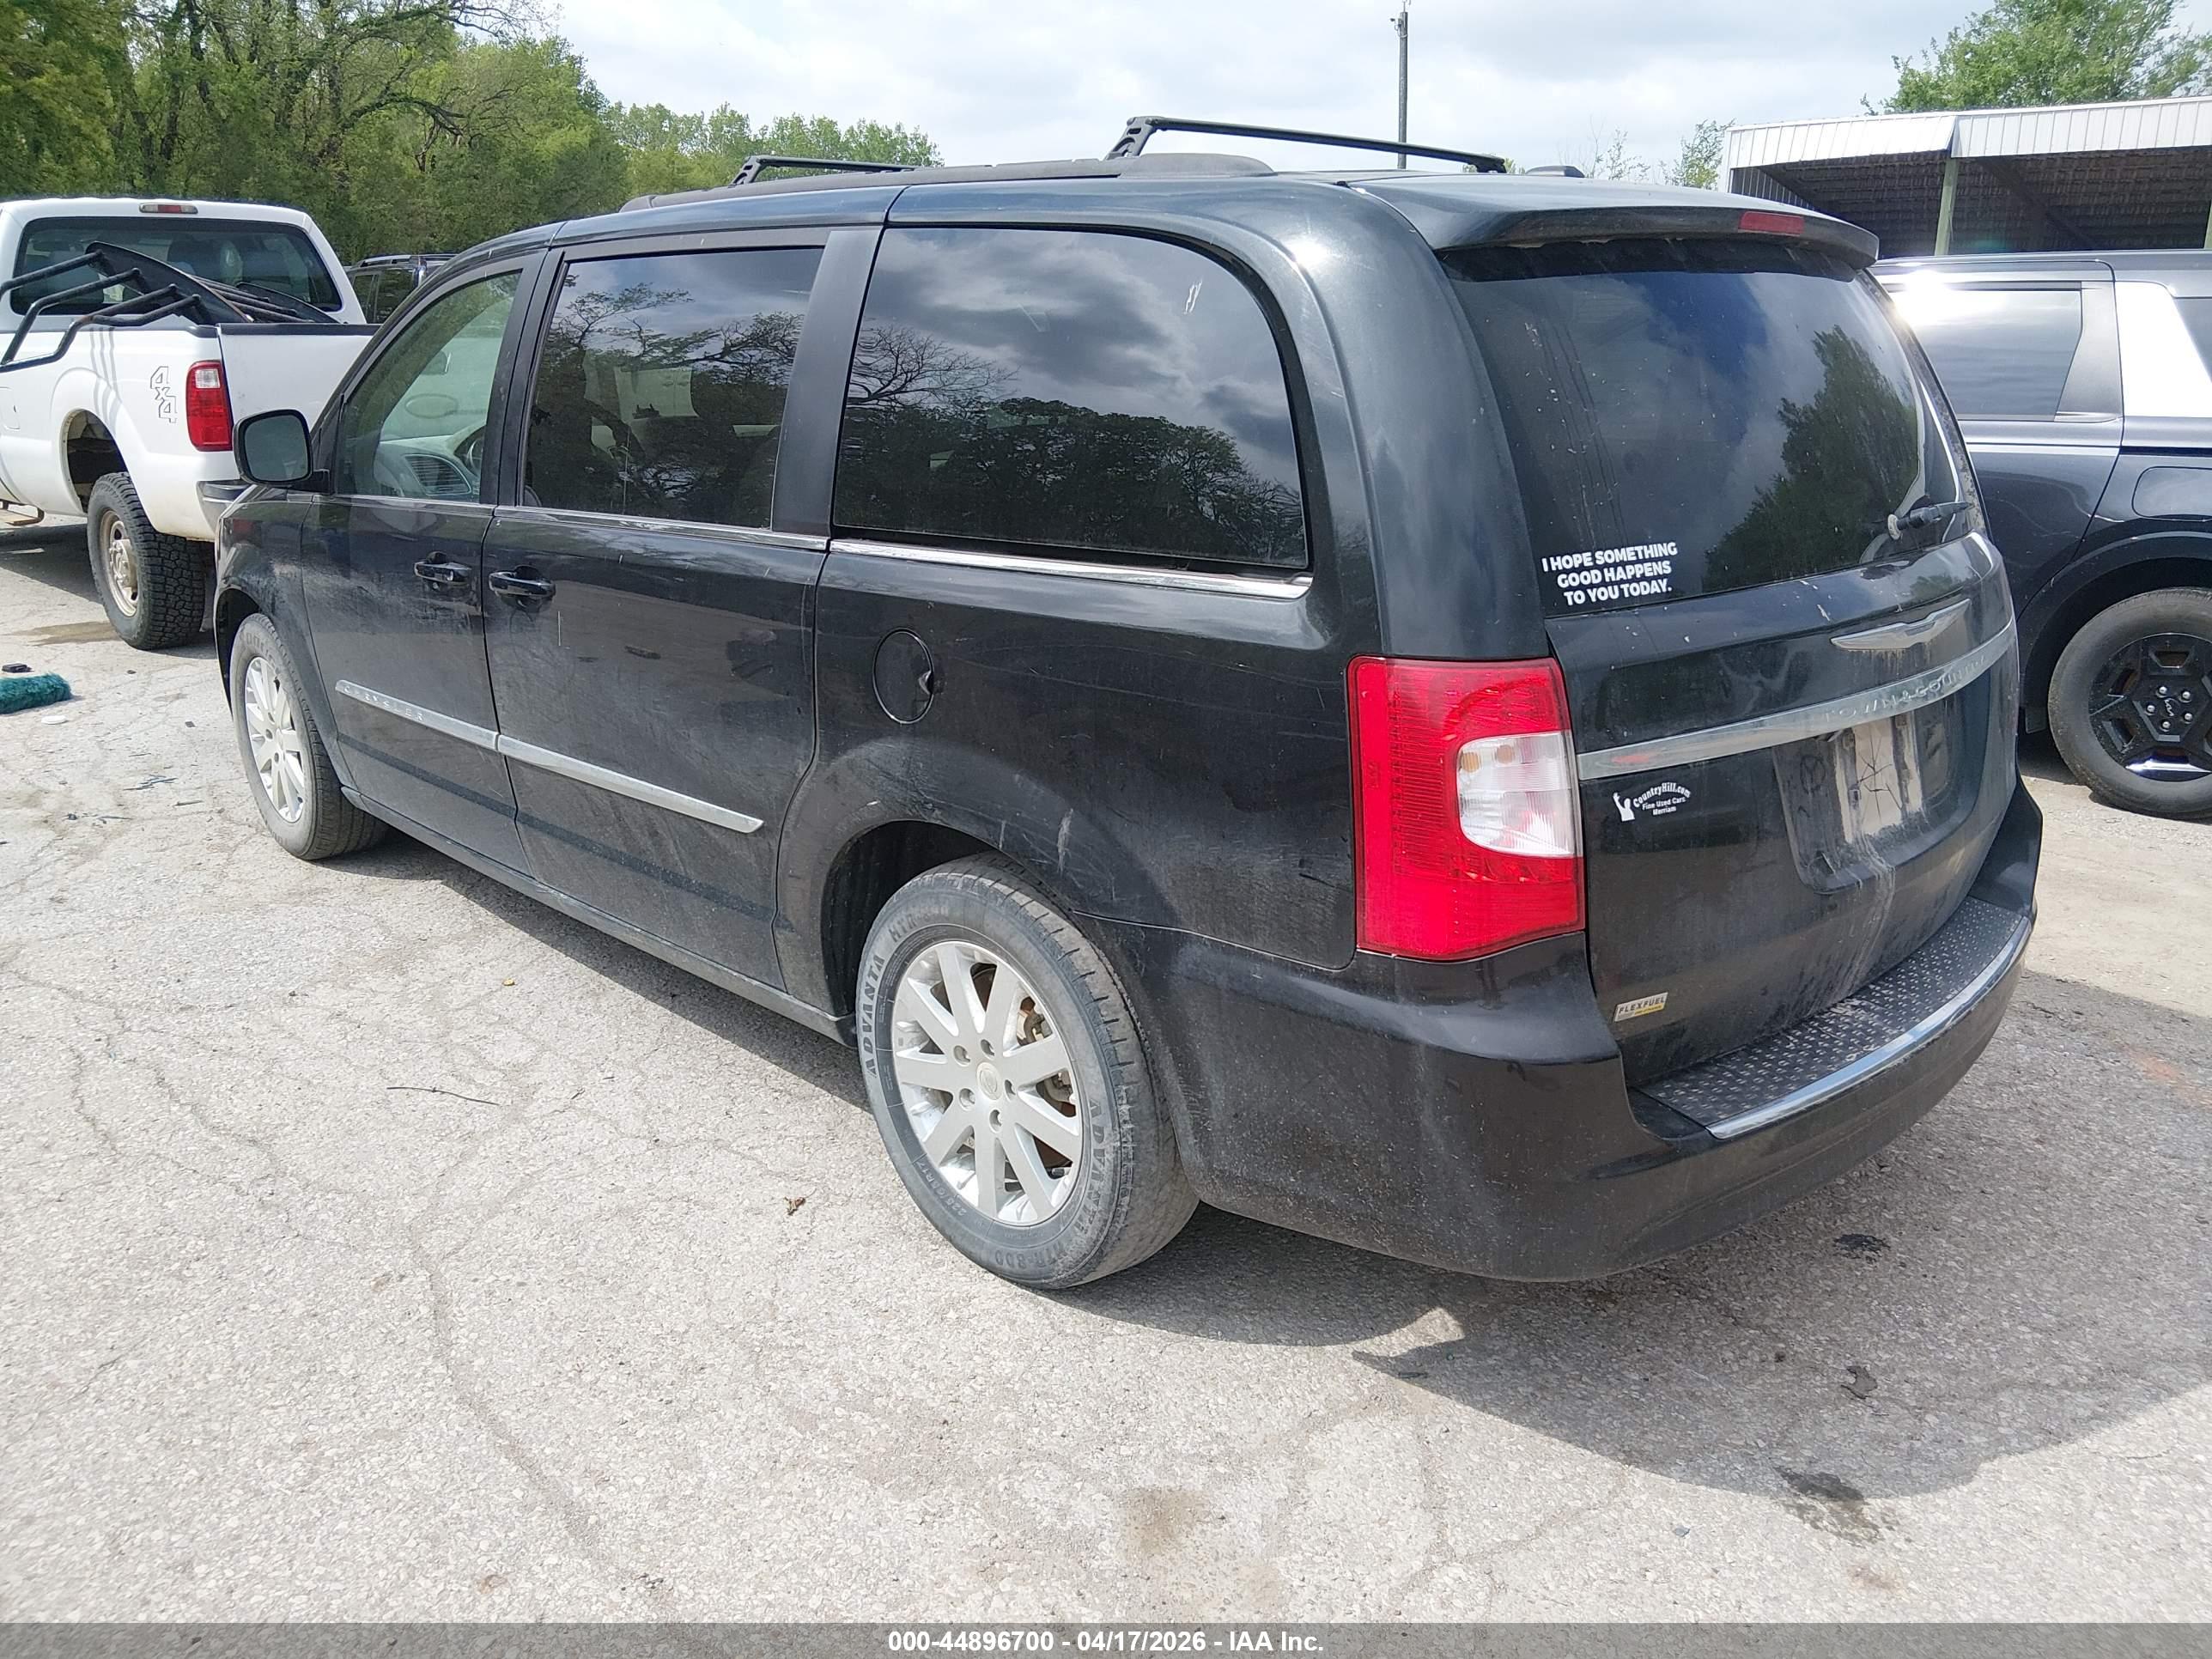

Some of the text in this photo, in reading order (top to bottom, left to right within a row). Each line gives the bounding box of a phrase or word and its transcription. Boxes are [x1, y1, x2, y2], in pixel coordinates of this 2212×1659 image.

[1541, 542, 1678, 572] I HOPE SOMETHING
[1557, 561, 1672, 588] GOOD HAPPENS
[1564, 578, 1672, 606] TO YOU TODAY.
[1632, 782, 1692, 808] CountryHill.com
[1642, 796, 1686, 811] Fine Used Cars
[1652, 805, 1677, 816] Merriam
[861, 954, 885, 1079] ADVANTA
